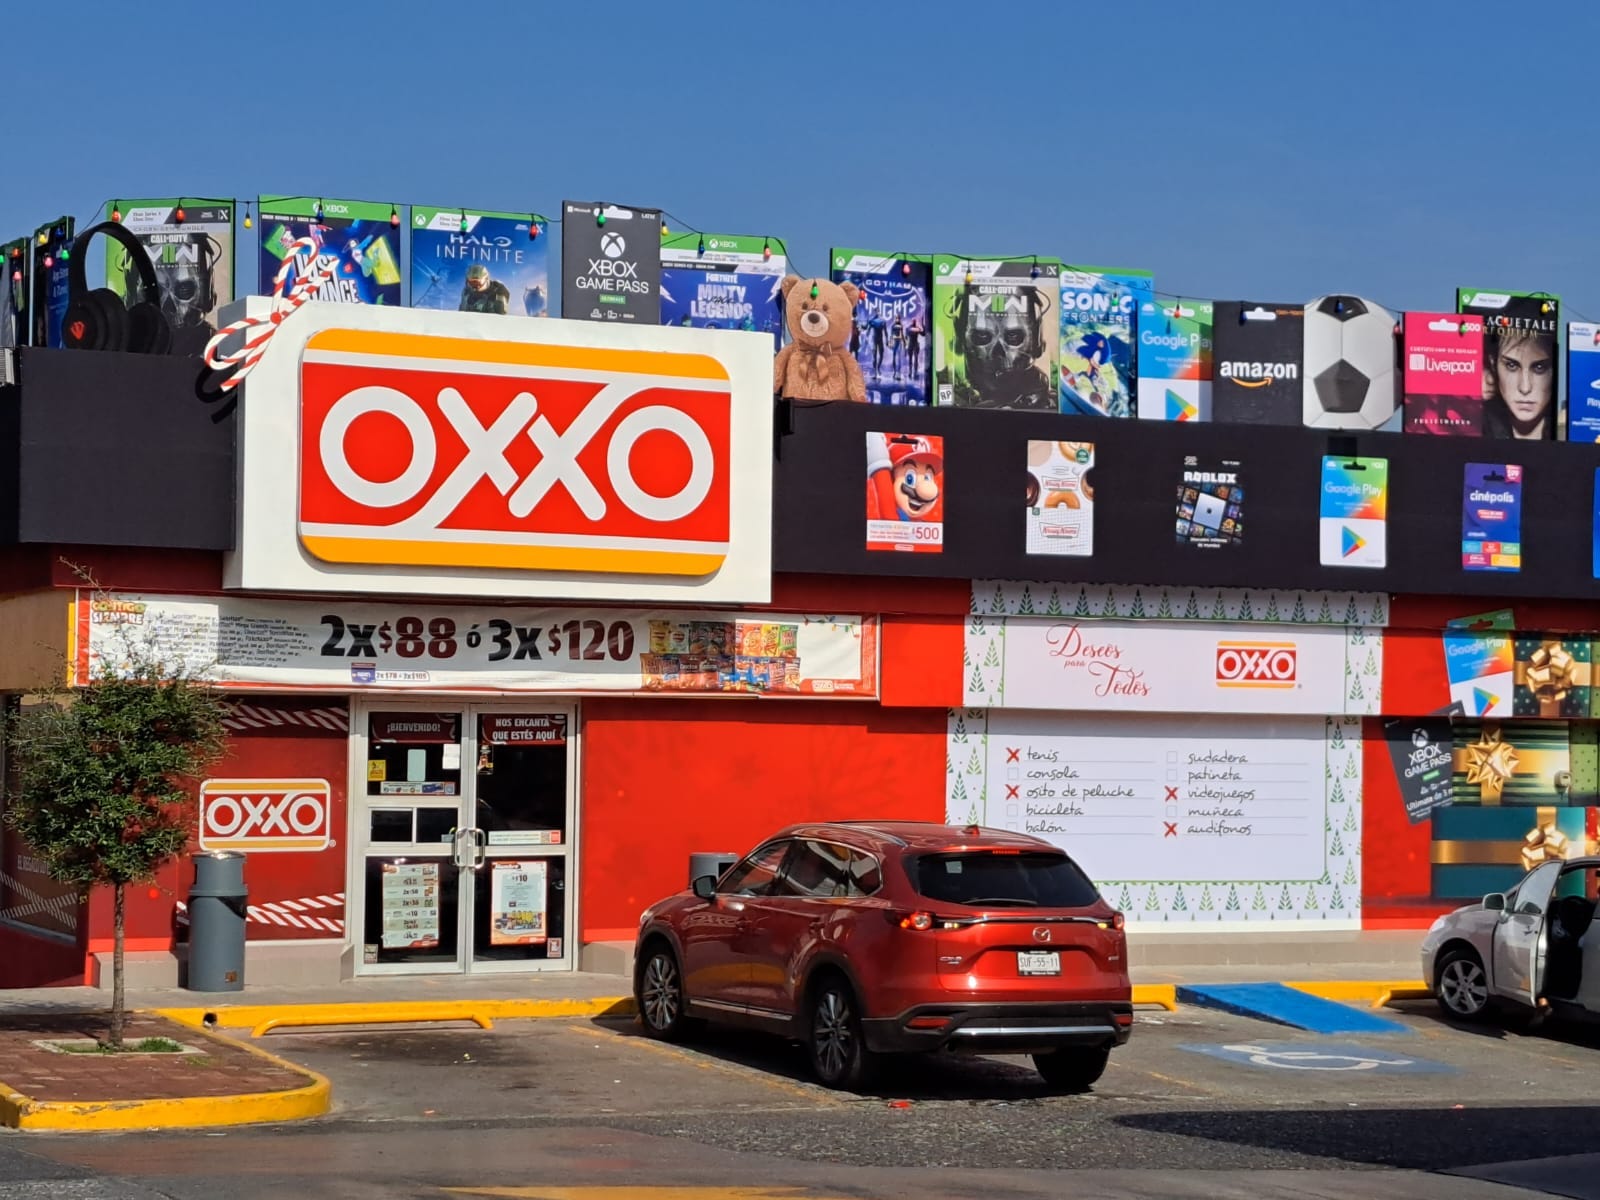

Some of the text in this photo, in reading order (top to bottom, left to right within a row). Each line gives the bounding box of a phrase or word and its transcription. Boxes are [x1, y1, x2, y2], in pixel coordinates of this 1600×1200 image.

[325, 204, 348, 213] XBOX
[450, 233, 512, 247] HALO
[436, 244, 524, 264] INFINITE
[588, 258, 638, 279] XBOX
[576, 276, 649, 294] GAME PASS
[706, 272, 738, 284] FORTNITE
[865, 279, 912, 289] GOTHAM
[698, 283, 747, 303] MINTY
[979, 286, 995, 294] CALL
[691, 300, 753, 320] LEGENDS
[1523, 318, 1555, 331] TALE
[1141, 330, 1188, 350] Google
[1220, 360, 1297, 380] amazon
[1427, 358, 1476, 375] Liverpool
[318, 382, 716, 524] OXXO
[1183, 471, 1237, 484] ROBLOX
[1325, 481, 1383, 499] Google Play
[1470, 489, 1514, 504] cinépolis
[1045, 622, 1125, 659] Deseos
[1449, 637, 1507, 657] Google Play
[1063, 657, 1087, 669] para
[1218, 649, 1295, 680] OXXO
[1088, 660, 1153, 697] Todos
[387, 722, 441, 733] ¡BIENVENIDO!
[495, 718, 550, 727] NOS ENCANTA
[492, 728, 556, 741] QUE ESTÉS AQUÍ
[1027, 745, 1060, 763] tenis
[1188, 749, 1248, 765] sudadera
[1408, 742, 1442, 766] XBOX
[1027, 766, 1080, 780] consola
[1404, 752, 1452, 778] GAME PASS
[1188, 766, 1243, 784] patineta
[1027, 783, 1135, 801] osito de peluche
[1188, 785, 1256, 803] videojuegos
[206, 796, 324, 836] OXXO
[1026, 802, 1084, 816] bicicleta
[1188, 806, 1244, 817] muñeca
[1025, 820, 1066, 833] balón
